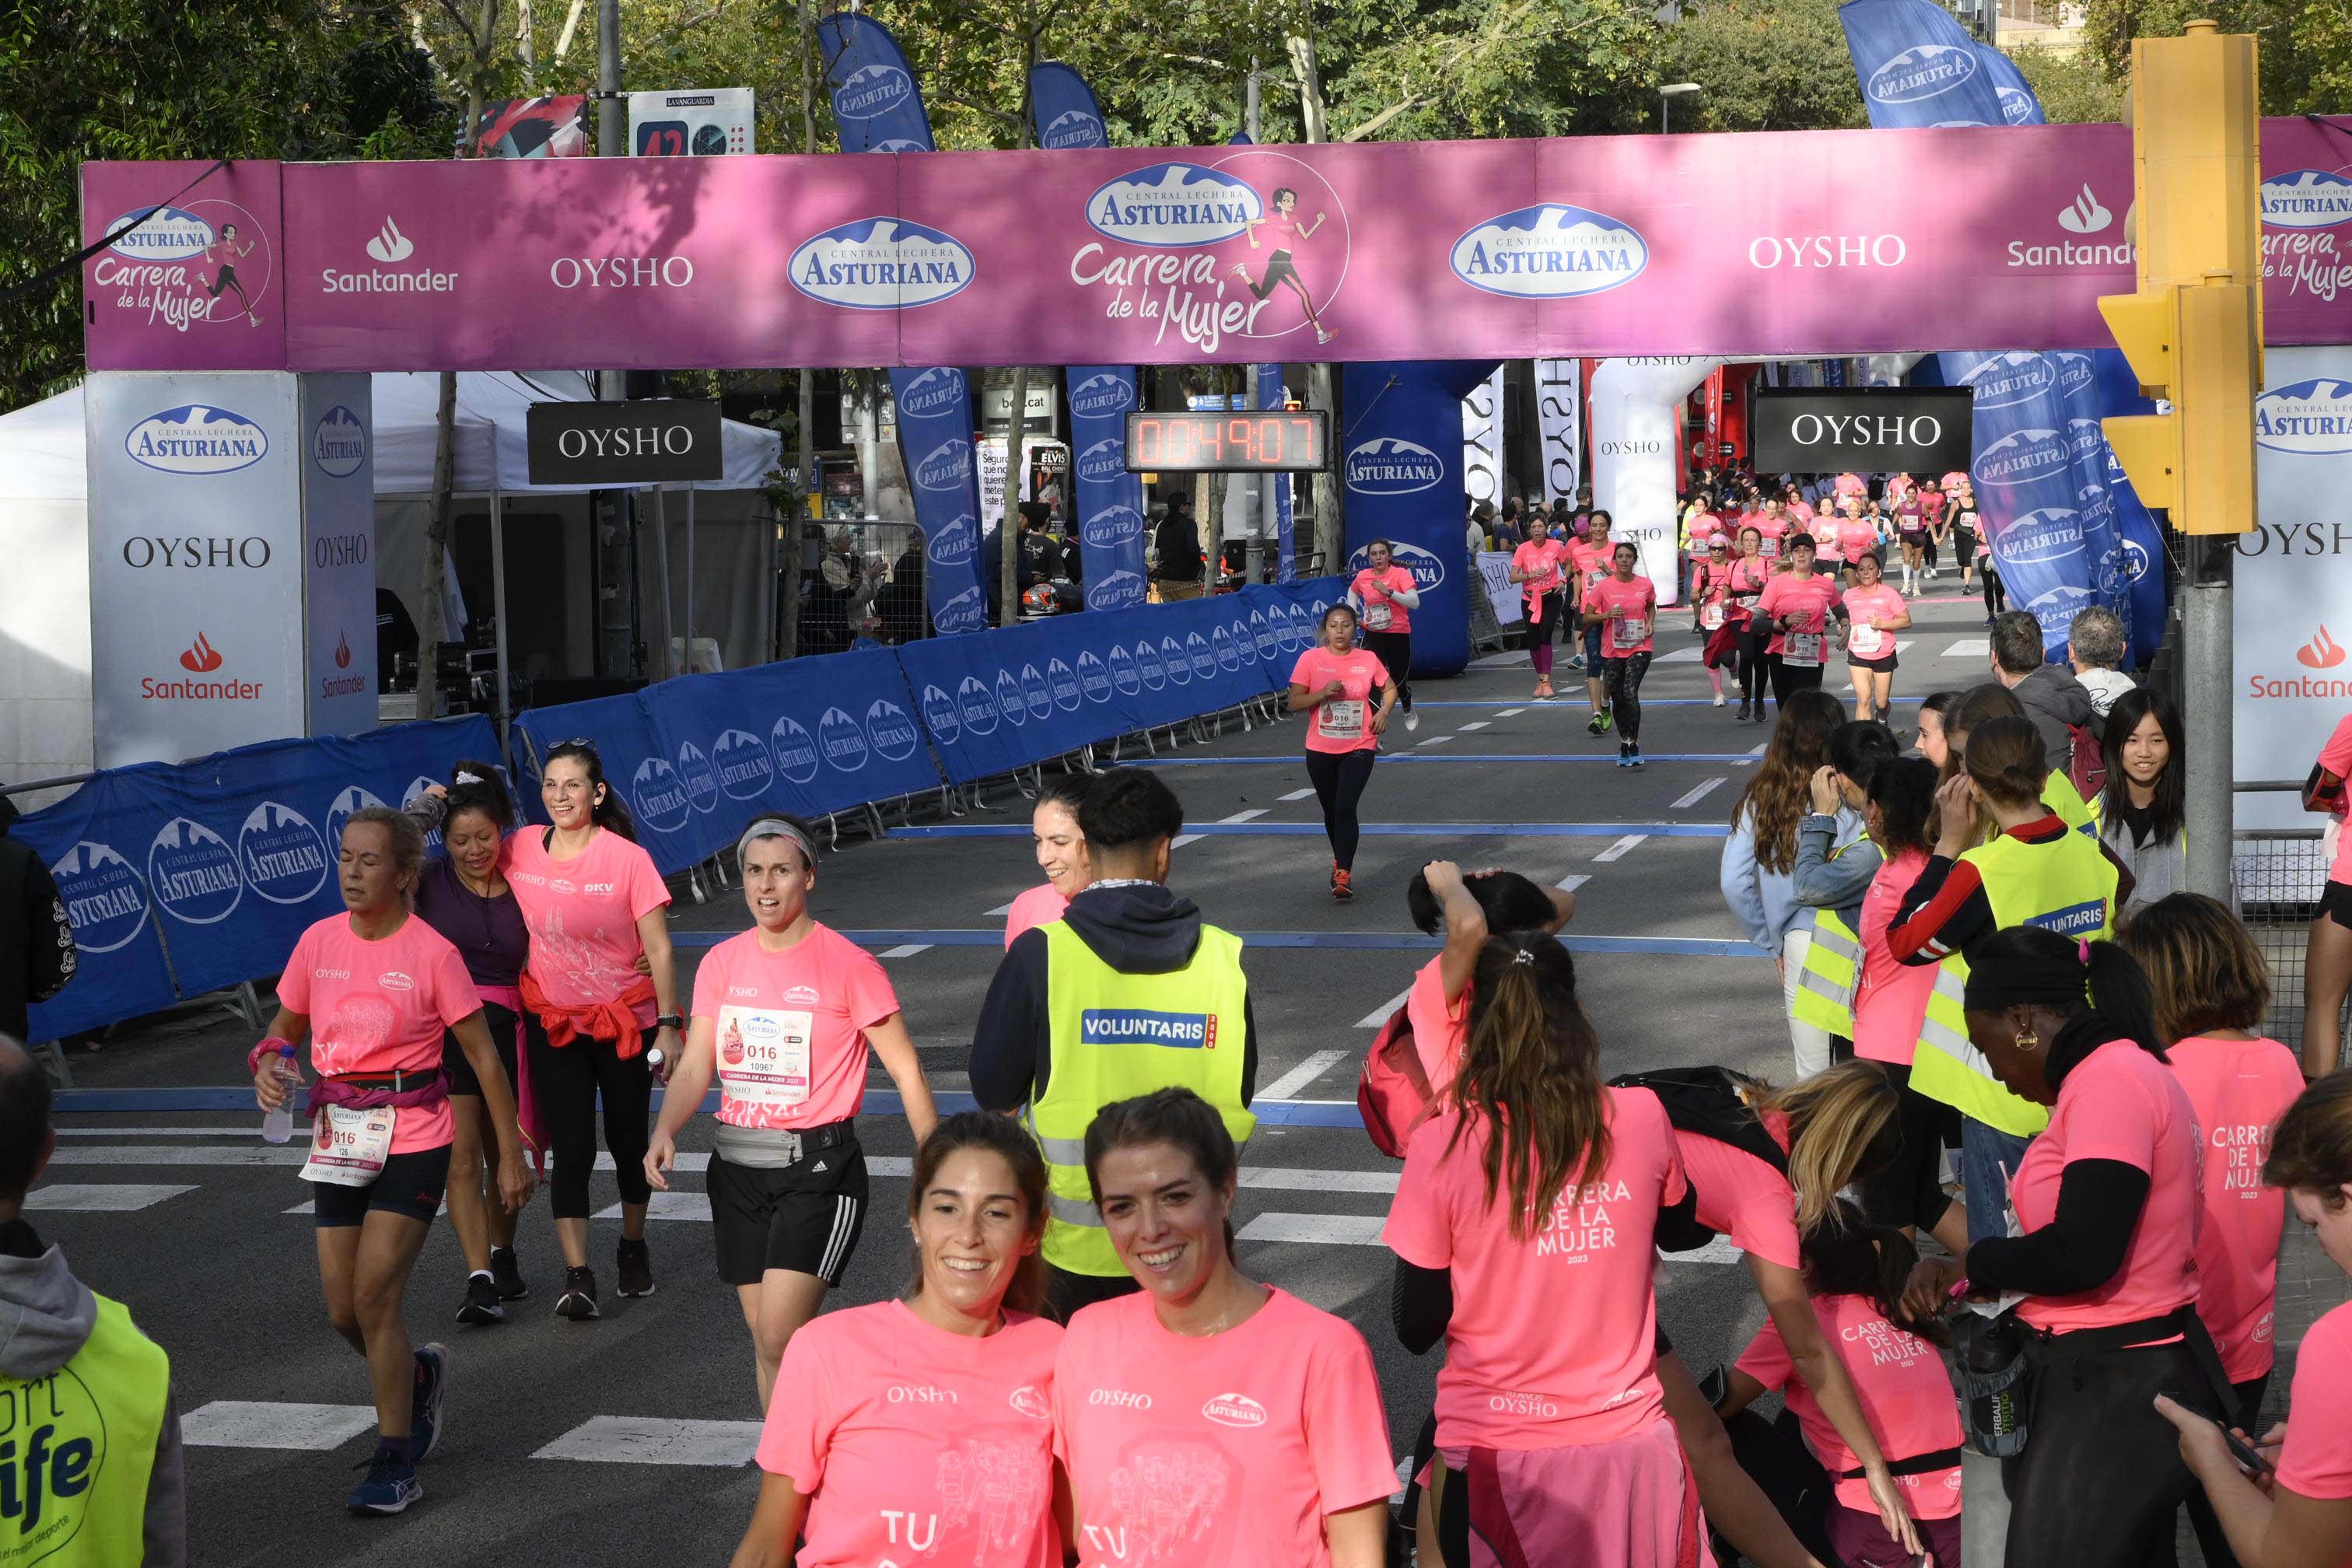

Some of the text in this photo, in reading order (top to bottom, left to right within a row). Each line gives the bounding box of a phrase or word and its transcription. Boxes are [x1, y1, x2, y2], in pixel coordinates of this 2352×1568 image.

[667, 96, 714, 106] LA VANGUARDIA
[1126, 191, 1183, 201] CENTRAL
[2261, 192, 2352, 213] ASTURIAN
[1099, 194, 1248, 226] ASTURIANA
[113, 226, 206, 247] ASTURIANA
[1496, 235, 1626, 247] CENTRAL LECHERA
[2262, 233, 2335, 255] arrera
[831, 248, 954, 258] CENTRAL LECHERA
[1465, 240, 1633, 275] ASTURIANA
[1748, 234, 1907, 270] OYSHO
[2007, 240, 2137, 267] Santand
[94, 257, 186, 287] Carrera
[551, 256, 695, 289] OYSHO
[803, 251, 961, 286] ASTURIANA
[1070, 242, 1216, 286] Carrera
[323, 268, 458, 292] Santander
[2263, 251, 2352, 302] e la Muje
[117, 284, 221, 332] de la Mujer
[1105, 281, 1270, 354] de la Mujer
[1791, 414, 1941, 446] OYSHO
[2256, 408, 2352, 436] ASTURIA
[136, 430, 258, 457] ASTURIANA
[317, 432, 362, 460] ASTURIANA
[558, 425, 693, 458] OYSHO
[1138, 421, 1313, 463] 00:49:07
[1601, 440, 1661, 455] OYSHO
[1041, 453, 1066, 463] ELVIS
[984, 467, 997, 477] que
[1348, 460, 1437, 482] ASTURIANA
[1626, 527, 1662, 542] SHO
[2235, 522, 2352, 558] OYSH
[123, 537, 271, 569] OYSHO
[316, 534, 366, 569] OYSHO
[141, 677, 264, 700] Santander
[322, 674, 366, 699] Santander
[2249, 675, 2352, 698] Santan
[716, 757, 772, 786] ASTURIANA
[246, 842, 325, 882] ASTURIANA
[156, 861, 239, 902] ASTURIANA
[513, 871, 545, 885] OYSHO
[584, 884, 614, 892] DKV
[69, 884, 142, 929] STURIANA
[316, 968, 350, 979] OYSHO
[729, 985, 758, 997] YSHO
[1085, 1018, 1203, 1039] VOLUNTARIS
[747, 1045, 777, 1059] 016
[750, 1062, 773, 1072] 10967
[334, 1111, 362, 1121] ASTURIANA
[334, 1131, 356, 1144] 016
[2211, 1125, 2269, 1147] CARRE
[2229, 1146, 2267, 1167] DE L
[310, 1168, 333, 1177] OYSHO
[1580, 1205, 1611, 1227] LA
[1536, 1228, 1616, 1257] MUJER
[1567, 1255, 1588, 1265] 2023
[1866, 1331, 1913, 1350] DE LA
[1871, 1341, 1929, 1366] MUJER
[1090, 1388, 1152, 1409] OYSHO
[1490, 1396, 1557, 1417] OYSHO
[1207, 1403, 1261, 1422] ASTURIANA
[0, 1423, 93, 1536] ife
[35, 1515, 70, 1544] deporte
[880, 1510, 937, 1551] TU
[1083, 1524, 1125, 1559] TU
